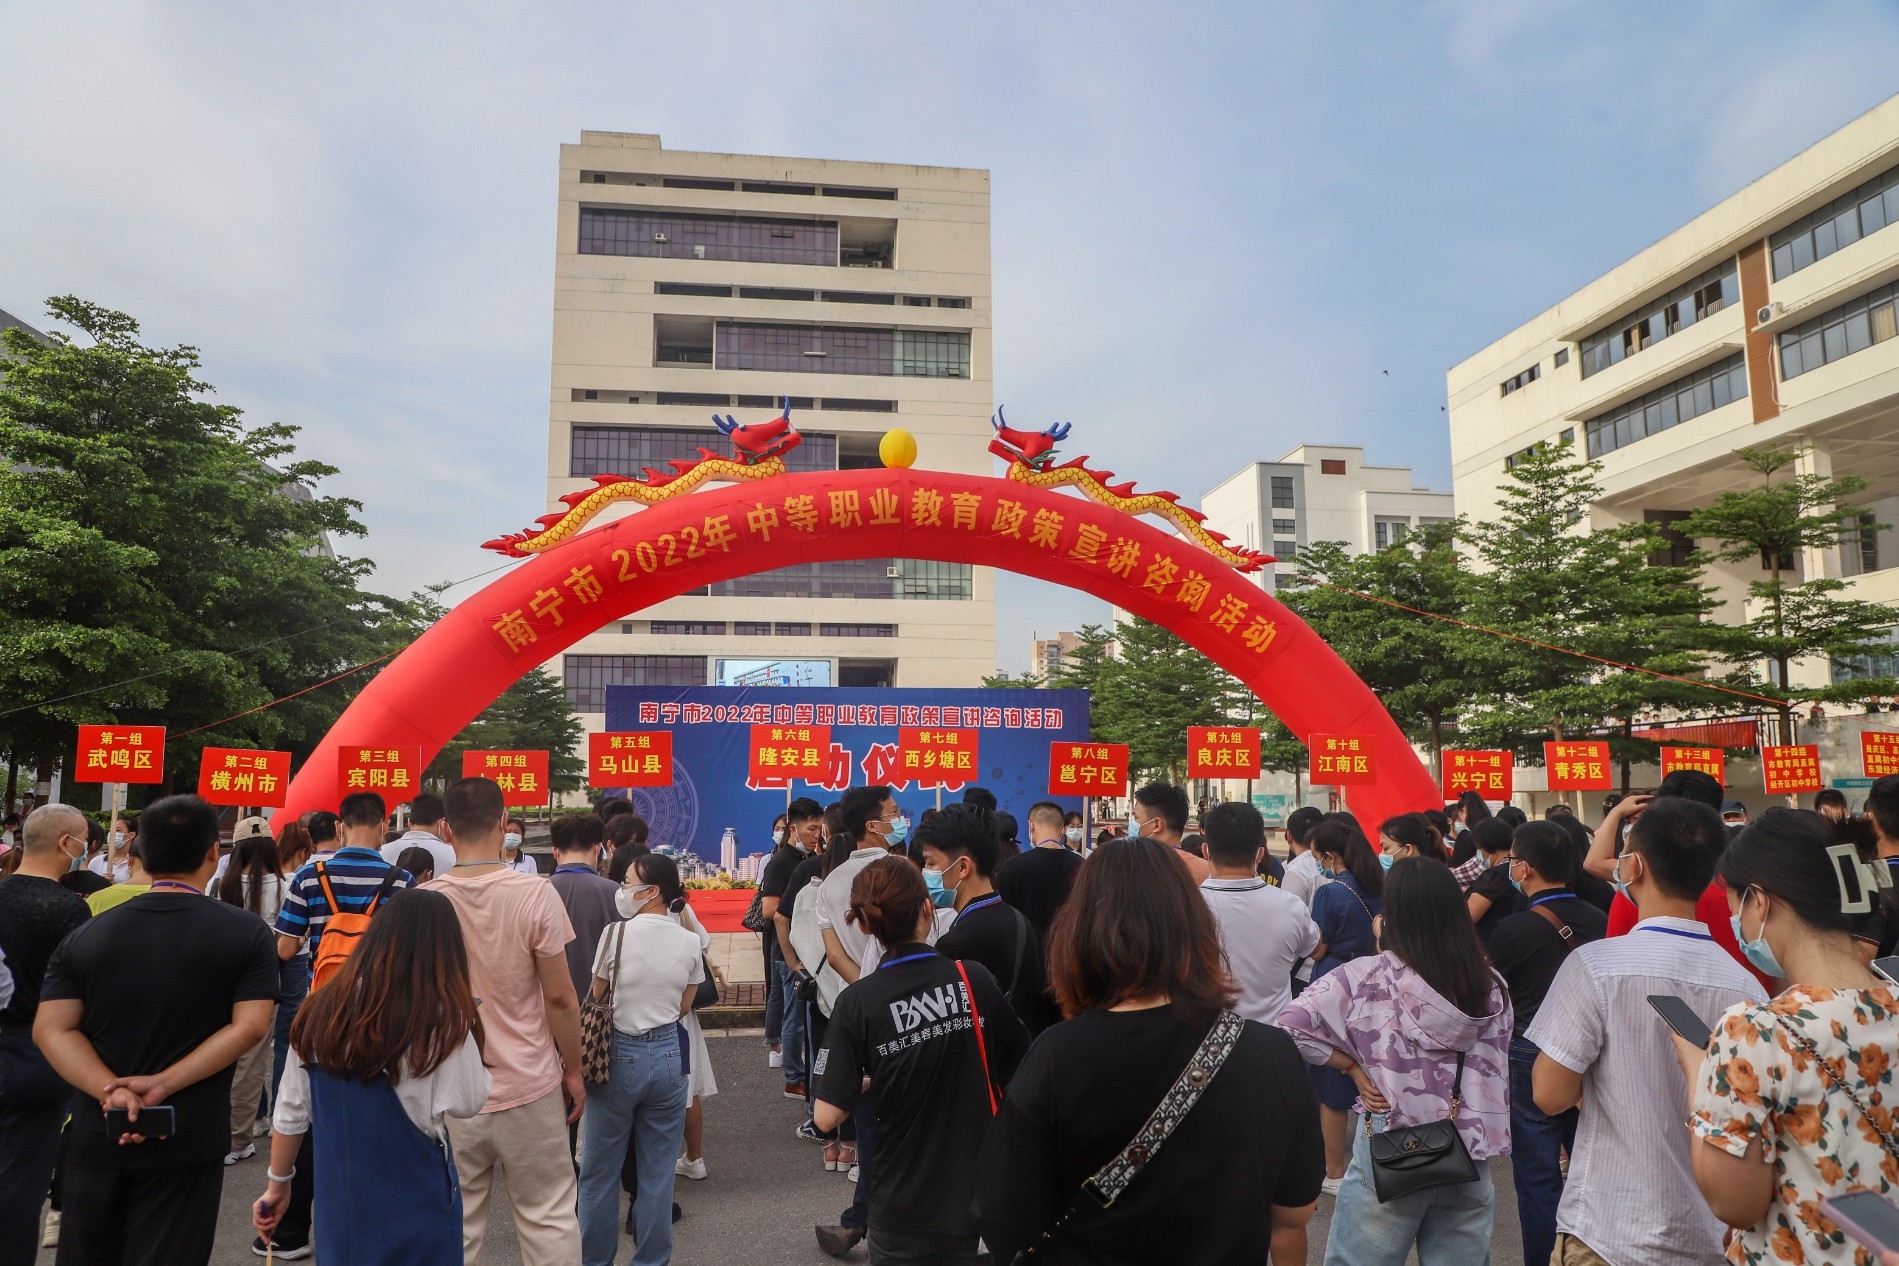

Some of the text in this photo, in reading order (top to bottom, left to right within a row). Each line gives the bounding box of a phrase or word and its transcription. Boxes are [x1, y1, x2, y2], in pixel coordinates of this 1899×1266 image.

[639, 702, 1063, 729] 南宁市2022年中等职业教育政策宣讲咨询活动
[100, 731, 143, 746] 第一组
[610, 735, 651, 750] 第五组
[771, 728, 811, 742] 第六组
[919, 731, 959, 745] 第七组
[1206, 731, 1243, 744] 第九组
[1326, 738, 1360, 751] 第十组
[1555, 745, 1599, 758] 第十二组
[1773, 746, 1807, 758] 第十四组
[87, 748, 153, 769] 武鸣区
[359, 749, 400, 763] 第三组
[758, 746, 821, 767] 隆安县
[904, 749, 972, 769] 西乡塘区
[1070, 746, 1109, 760] 第八组
[1197, 747, 1251, 767] 良庆区
[1674, 748, 1711, 761] 第十三组
[1866, 754, 1899, 765] 直属初中
[224, 754, 268, 770] 第二组
[485, 754, 527, 768] 第四组
[598, 754, 662, 775] 马山县
[1318, 754, 1369, 773] 江南区
[1454, 754, 1501, 768] 第十一组
[1768, 757, 1816, 769] 市教育局直属
[347, 767, 411, 788] 宾阳县
[1059, 764, 1117, 785] 邕宁区
[1554, 761, 1604, 780] 青秀区
[210, 771, 278, 794] 横州市
[480, 772, 538, 793] 林县
[1451, 771, 1505, 790] 兴宁区
[876, 1015, 985, 1057] 百美汇美容美发彩妆校
